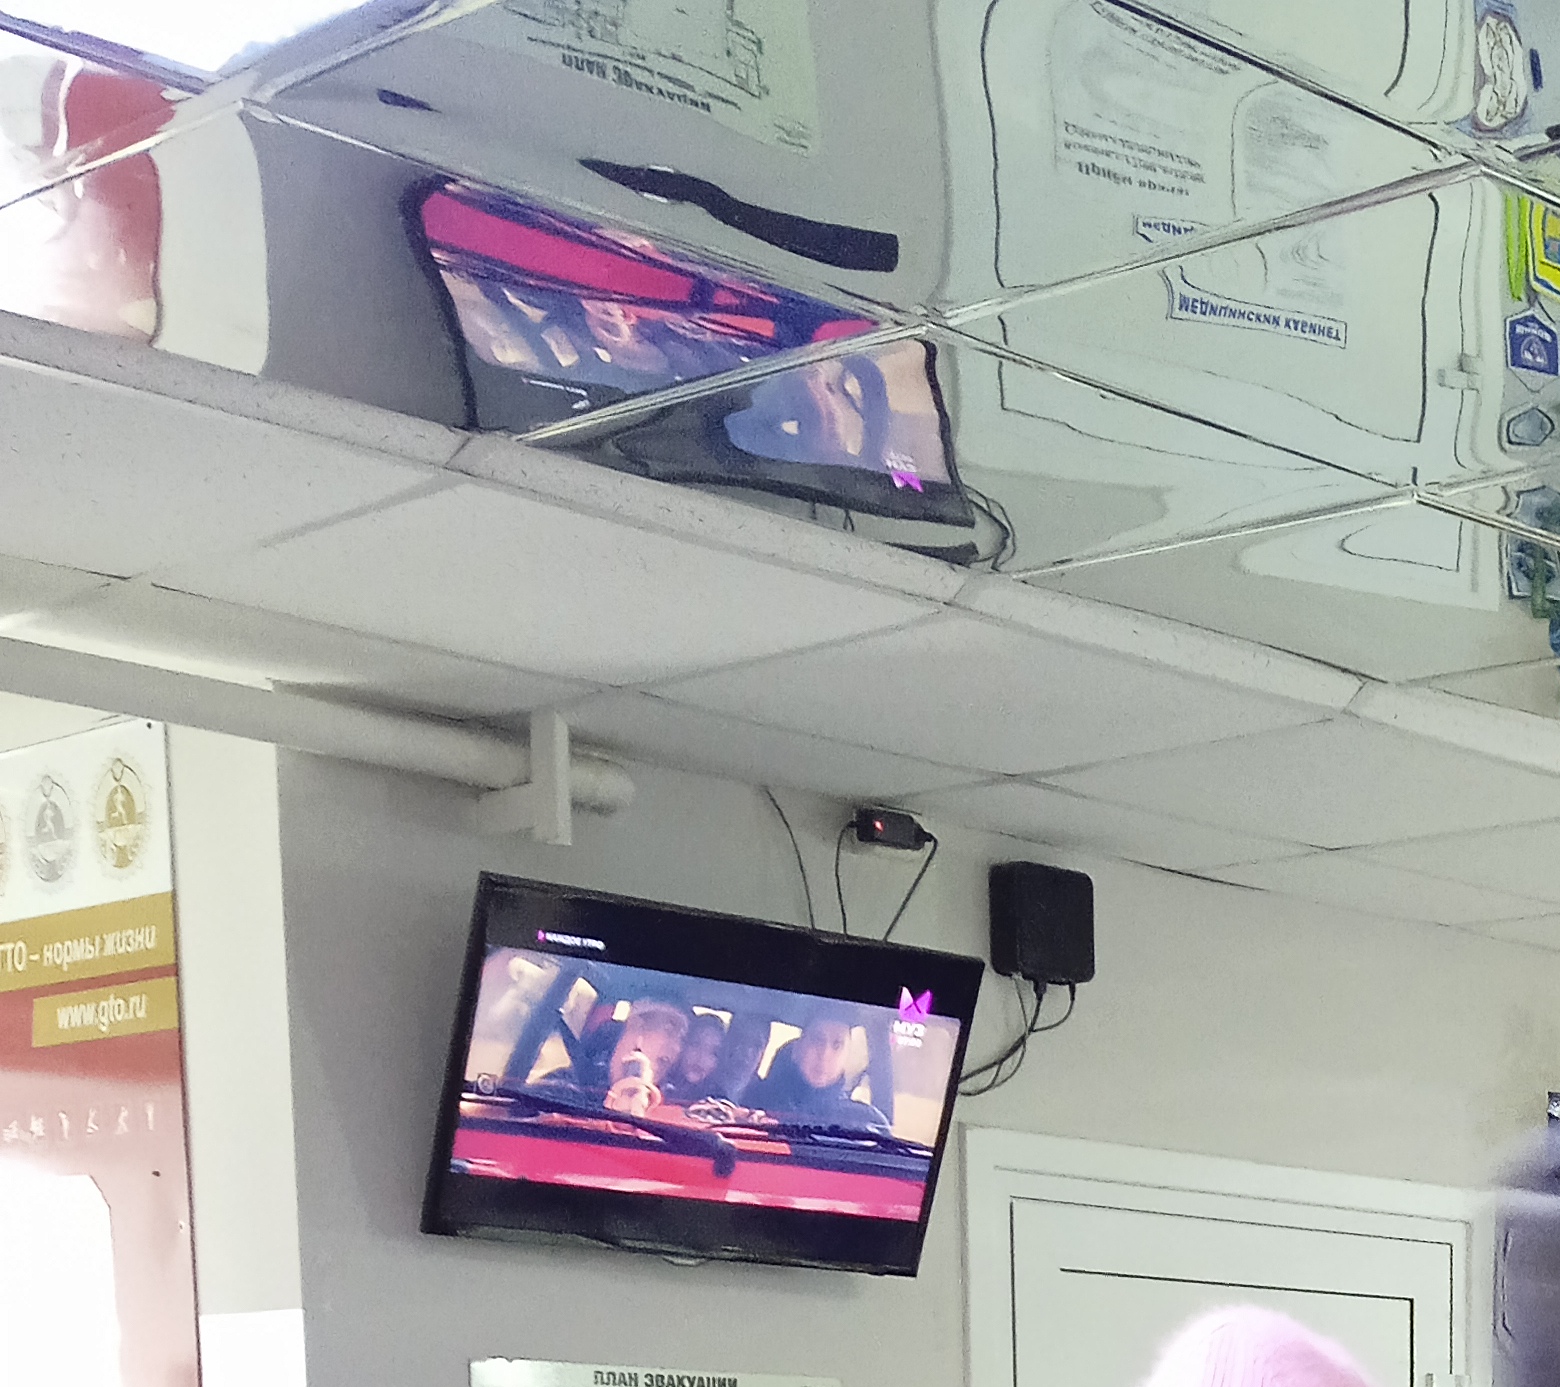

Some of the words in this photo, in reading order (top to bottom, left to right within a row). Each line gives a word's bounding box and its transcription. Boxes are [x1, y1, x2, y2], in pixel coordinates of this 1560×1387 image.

[42, 936, 101, 971] нормы
[102, 925, 157, 957] жизни
[56, 993, 148, 1034] www.gto.ru
[593, 1370, 639, 1387] ПЛАН
